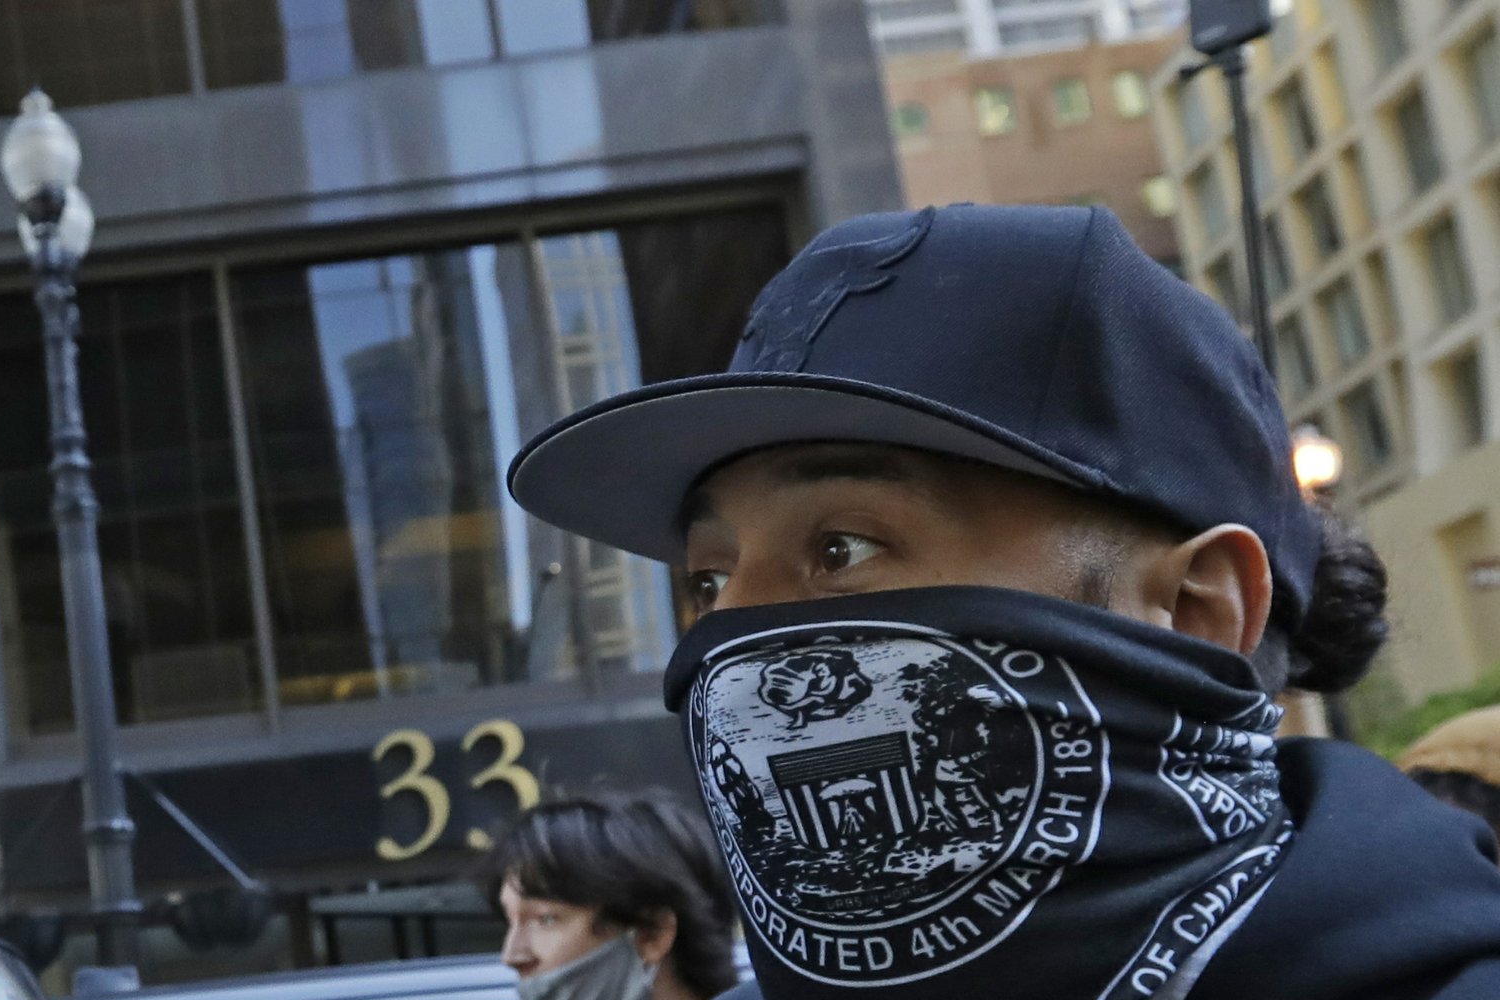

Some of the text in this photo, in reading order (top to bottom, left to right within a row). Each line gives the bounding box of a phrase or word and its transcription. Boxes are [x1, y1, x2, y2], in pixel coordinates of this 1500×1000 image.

[372, 719, 541, 861] 33
[911, 914, 981, 958] 4th
[973, 792, 1088, 917] MARCH
[1131, 943, 1178, 997] OF
